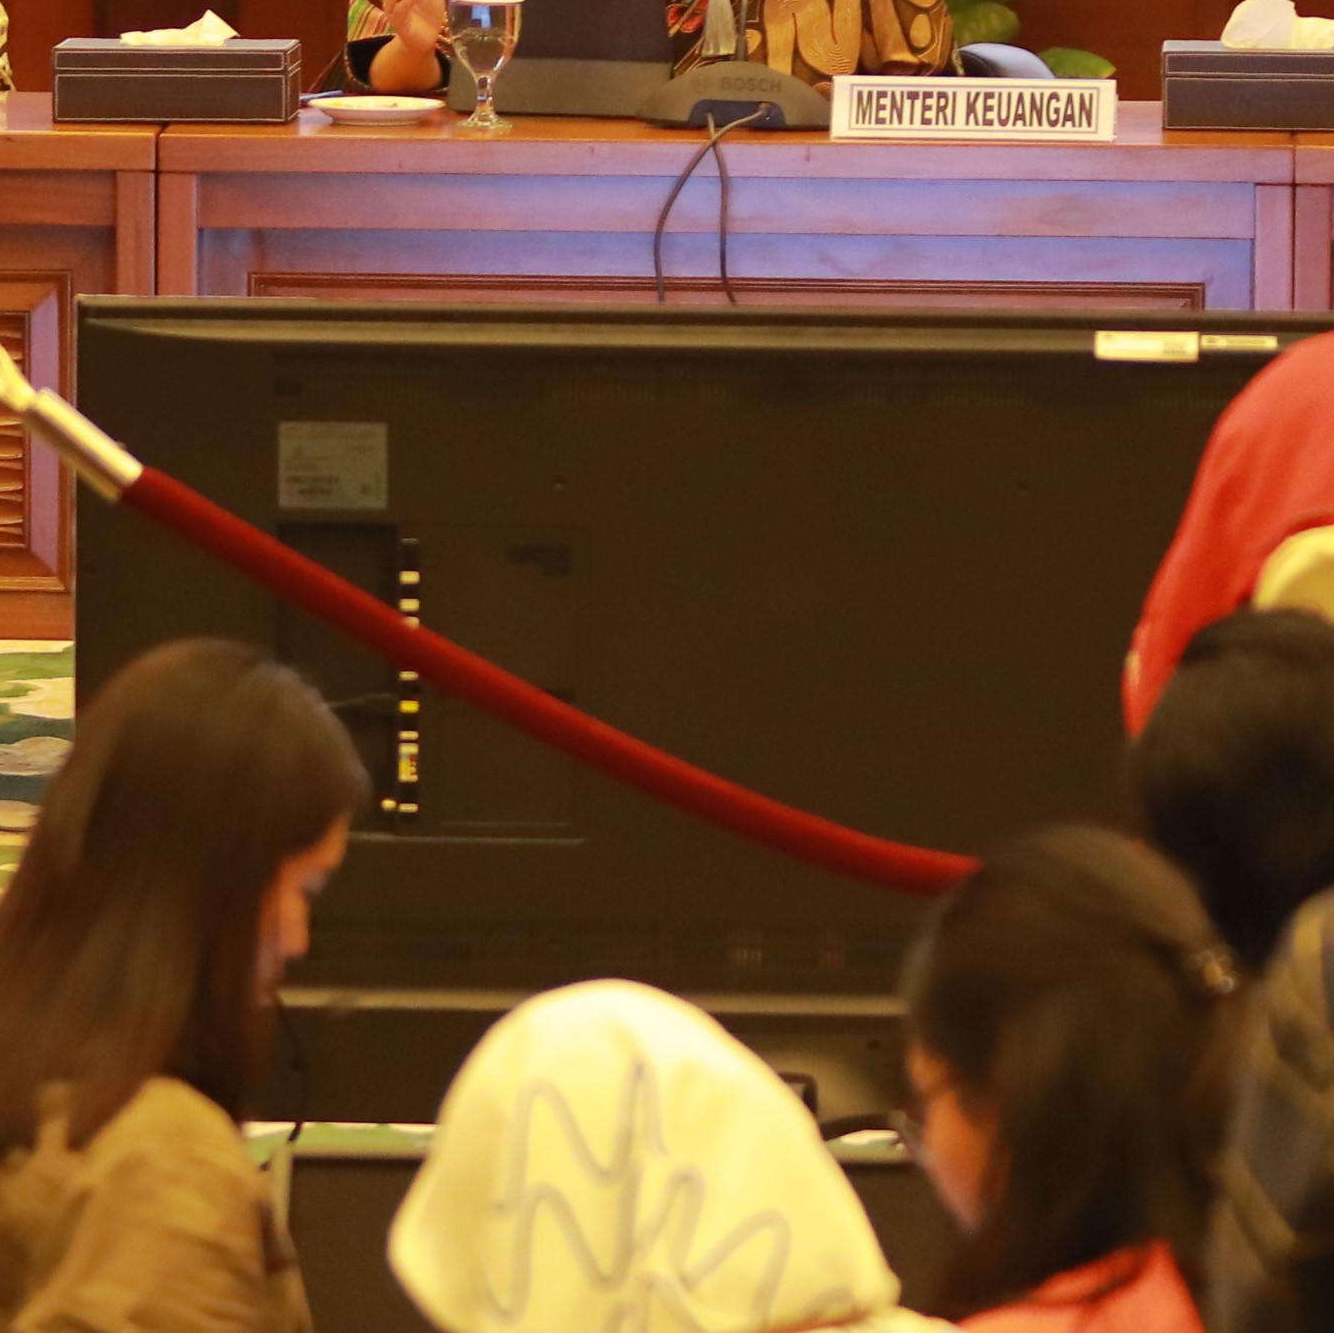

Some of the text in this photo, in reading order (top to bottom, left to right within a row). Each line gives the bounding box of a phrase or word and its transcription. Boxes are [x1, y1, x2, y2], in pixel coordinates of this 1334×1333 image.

[720, 77, 782, 93] BOSCH
[855, 90, 1094, 128] MENTERI KEUANGAN
